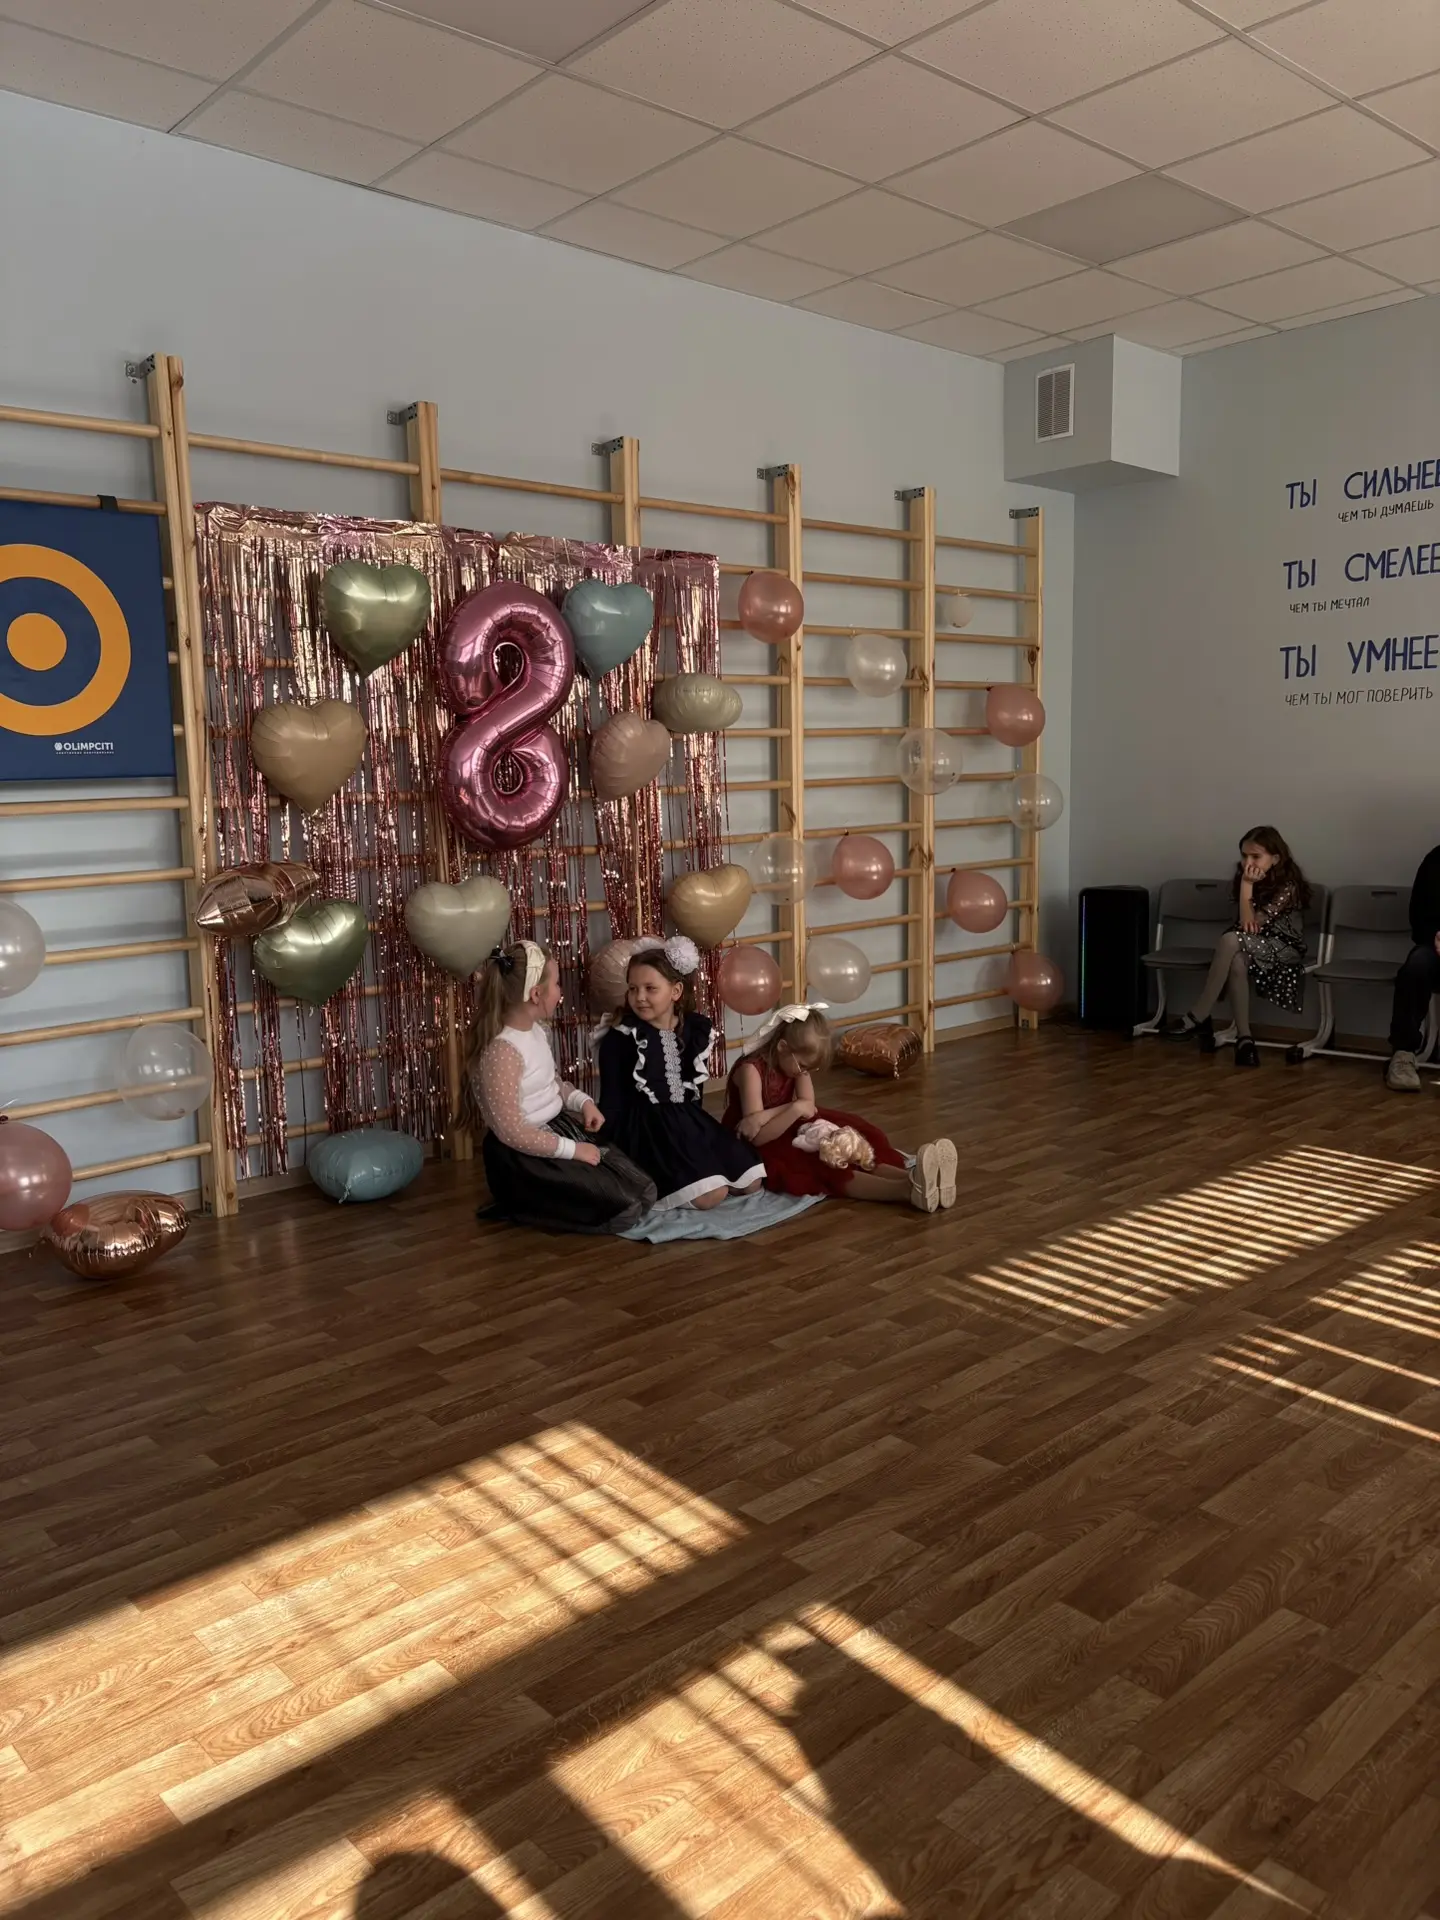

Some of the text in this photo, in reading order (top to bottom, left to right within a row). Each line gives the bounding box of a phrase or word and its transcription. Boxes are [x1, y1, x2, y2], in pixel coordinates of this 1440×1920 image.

[1285, 478, 1317, 509] ТЫ
[1337, 499, 1434, 522] ЧЕМ ТЫ ДУМАЕШЬ
[1283, 542, 1440, 590] ТЫ СМЕЛЕЕ
[1289, 597, 1370, 614] ЧЕМ ТЫ МЕЧТАЛ
[1279, 634, 1440, 679] ТЫ УМНЕЕ
[1285, 686, 1433, 706] ЧЕМ ТЫ МОГ ПОВЕРИТЬ
[438, 580, 575, 849] 8
